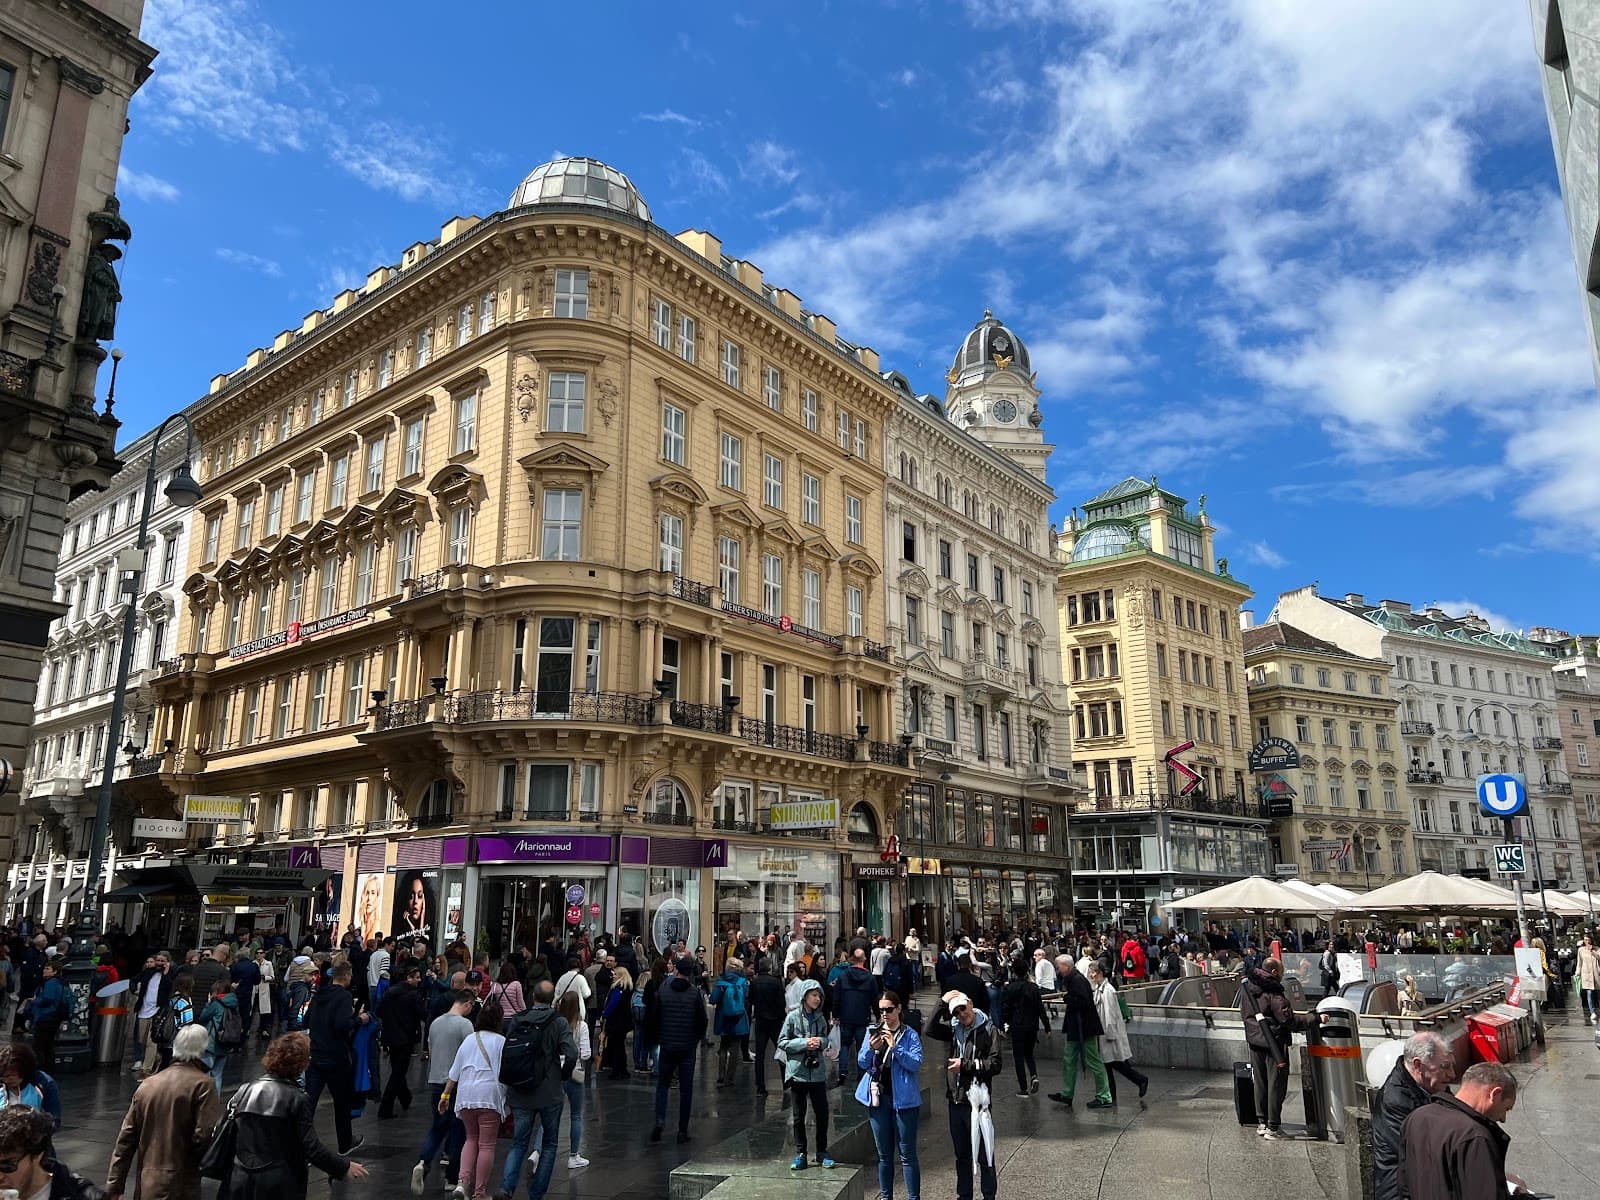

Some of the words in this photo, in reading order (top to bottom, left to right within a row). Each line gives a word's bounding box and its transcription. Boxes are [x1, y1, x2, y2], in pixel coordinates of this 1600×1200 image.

[721, 601, 746, 615] WIENER
[229, 644, 251, 658] WIENER
[1260, 756, 1287, 764] BUFFET
[1484, 781, 1518, 811] U
[191, 799, 240, 814] STURMAYR
[775, 802, 831, 823] STURMAYR
[137, 824, 184, 833] BIOGENA
[513, 840, 572, 854] Marionnaud
[1496, 847, 1522, 860] WC
[859, 867, 895, 876] APOTHEKE
